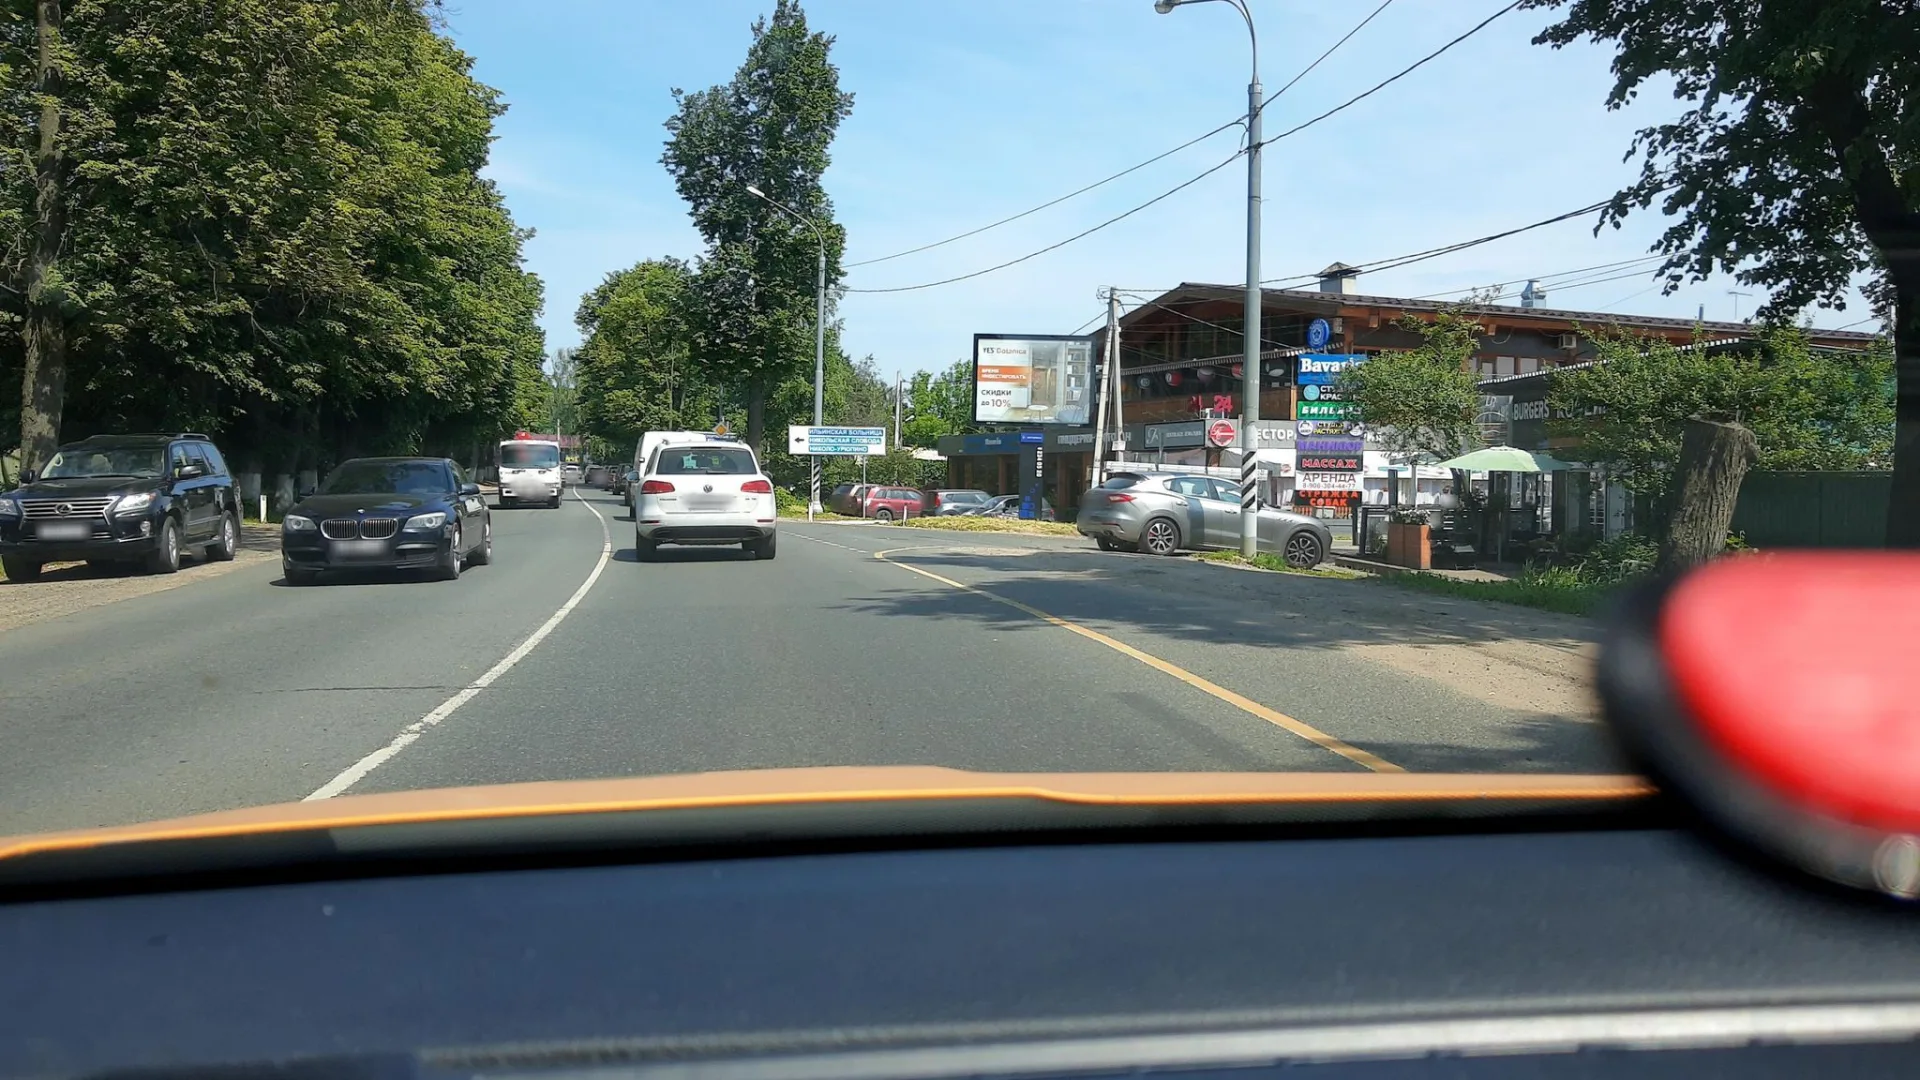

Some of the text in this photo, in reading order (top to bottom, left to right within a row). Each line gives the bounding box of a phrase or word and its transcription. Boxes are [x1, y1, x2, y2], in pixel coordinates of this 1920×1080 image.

[991, 398, 1012, 408] 10%
[1513, 399, 1550, 421] BURGERS
[1302, 458, 1358, 469] МАССАЖ
[1303, 473, 1356, 483] АРЕНДА
[1299, 490, 1358, 498] СТРИЖКА
[1310, 498, 1347, 506] СОБАК
